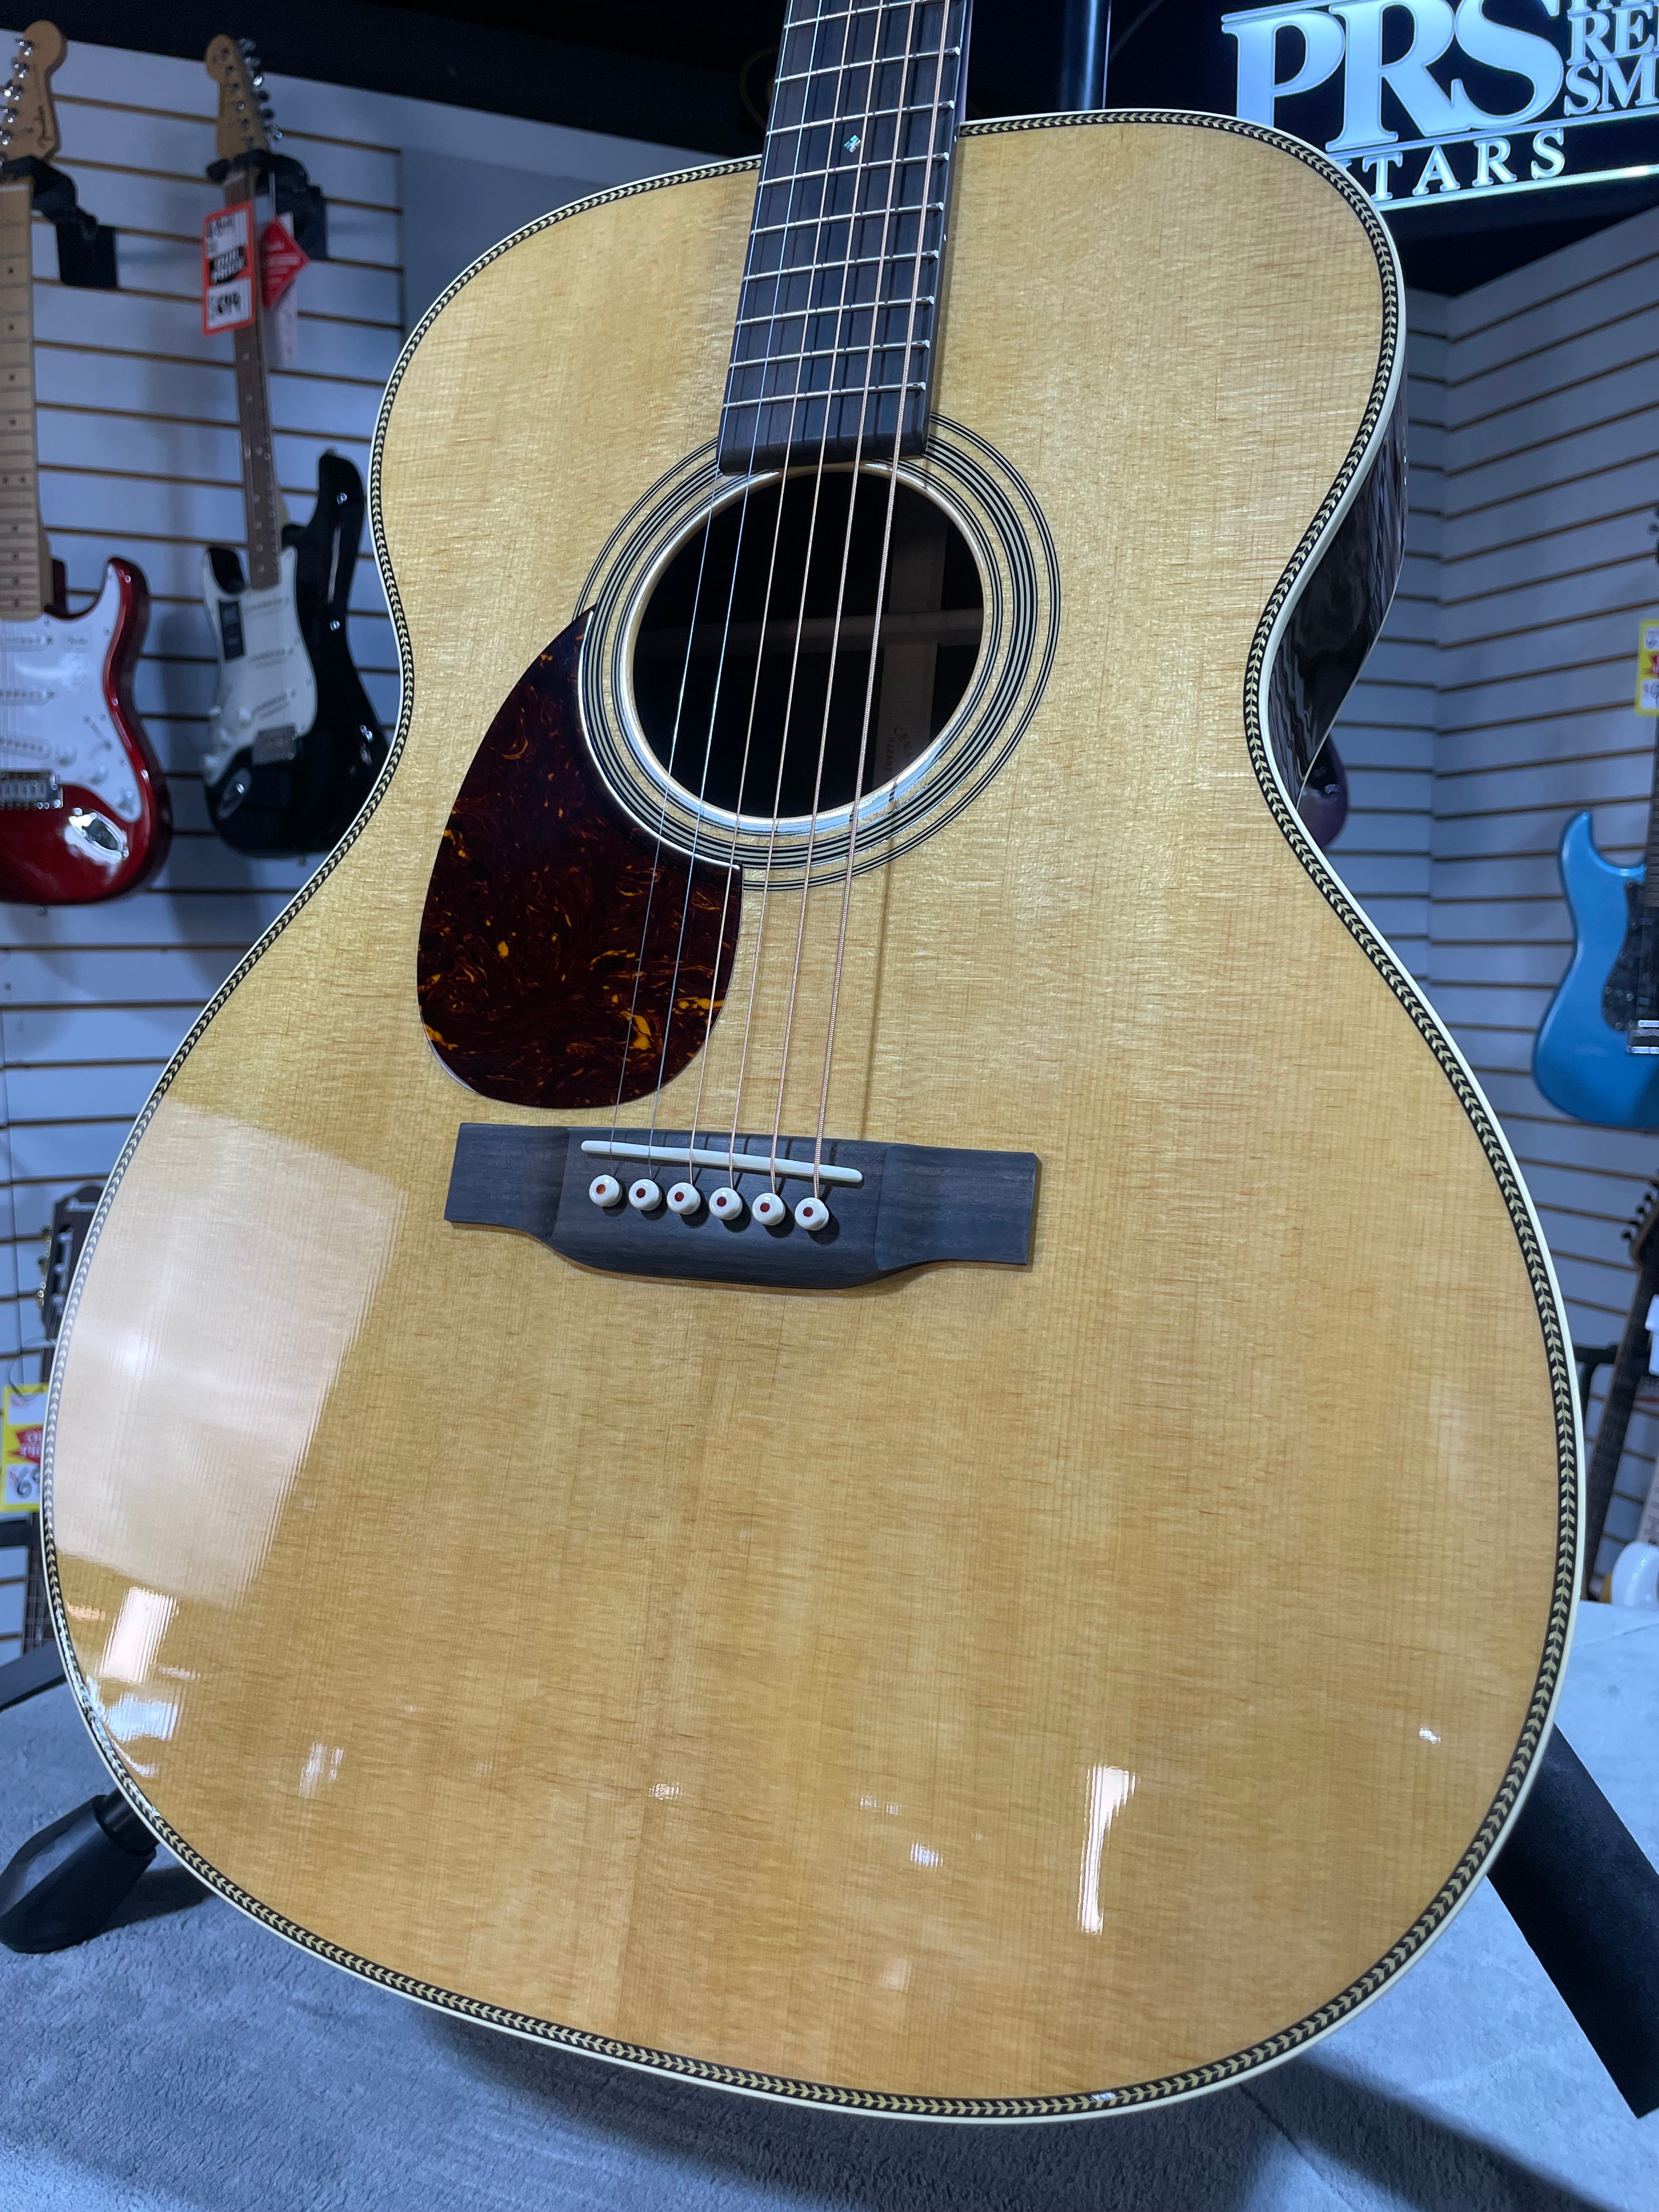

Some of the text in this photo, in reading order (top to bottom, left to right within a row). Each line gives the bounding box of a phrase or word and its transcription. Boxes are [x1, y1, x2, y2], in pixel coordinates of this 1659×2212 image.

[1566, 3, 1659, 65] RE
[1221, 0, 1564, 151] PRS
[1335, 129, 1566, 202] TARS
